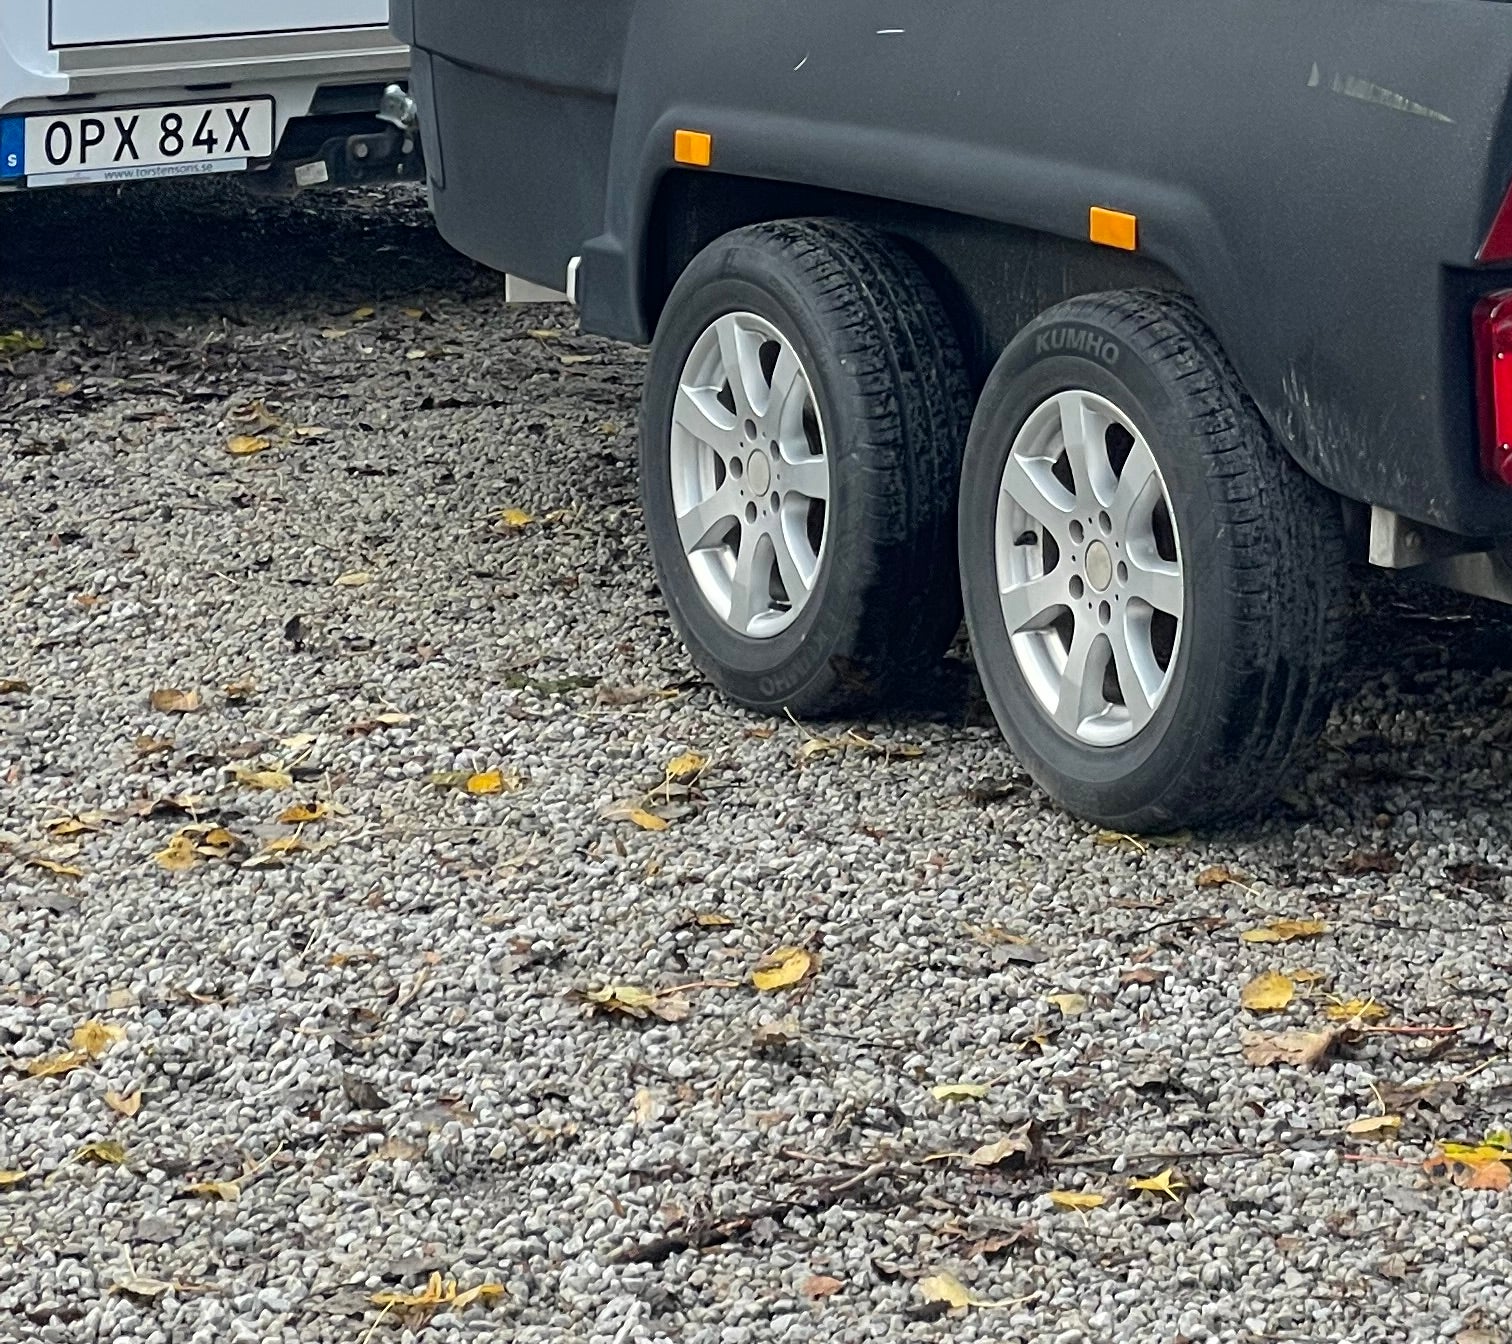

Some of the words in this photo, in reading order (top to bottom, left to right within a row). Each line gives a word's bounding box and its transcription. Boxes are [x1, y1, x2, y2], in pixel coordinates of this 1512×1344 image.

[7, 153, 18, 167] S
[44, 115, 140, 166] OPX
[158, 107, 251, 157] 84X
[1035, 327, 1120, 366] KUMHO
